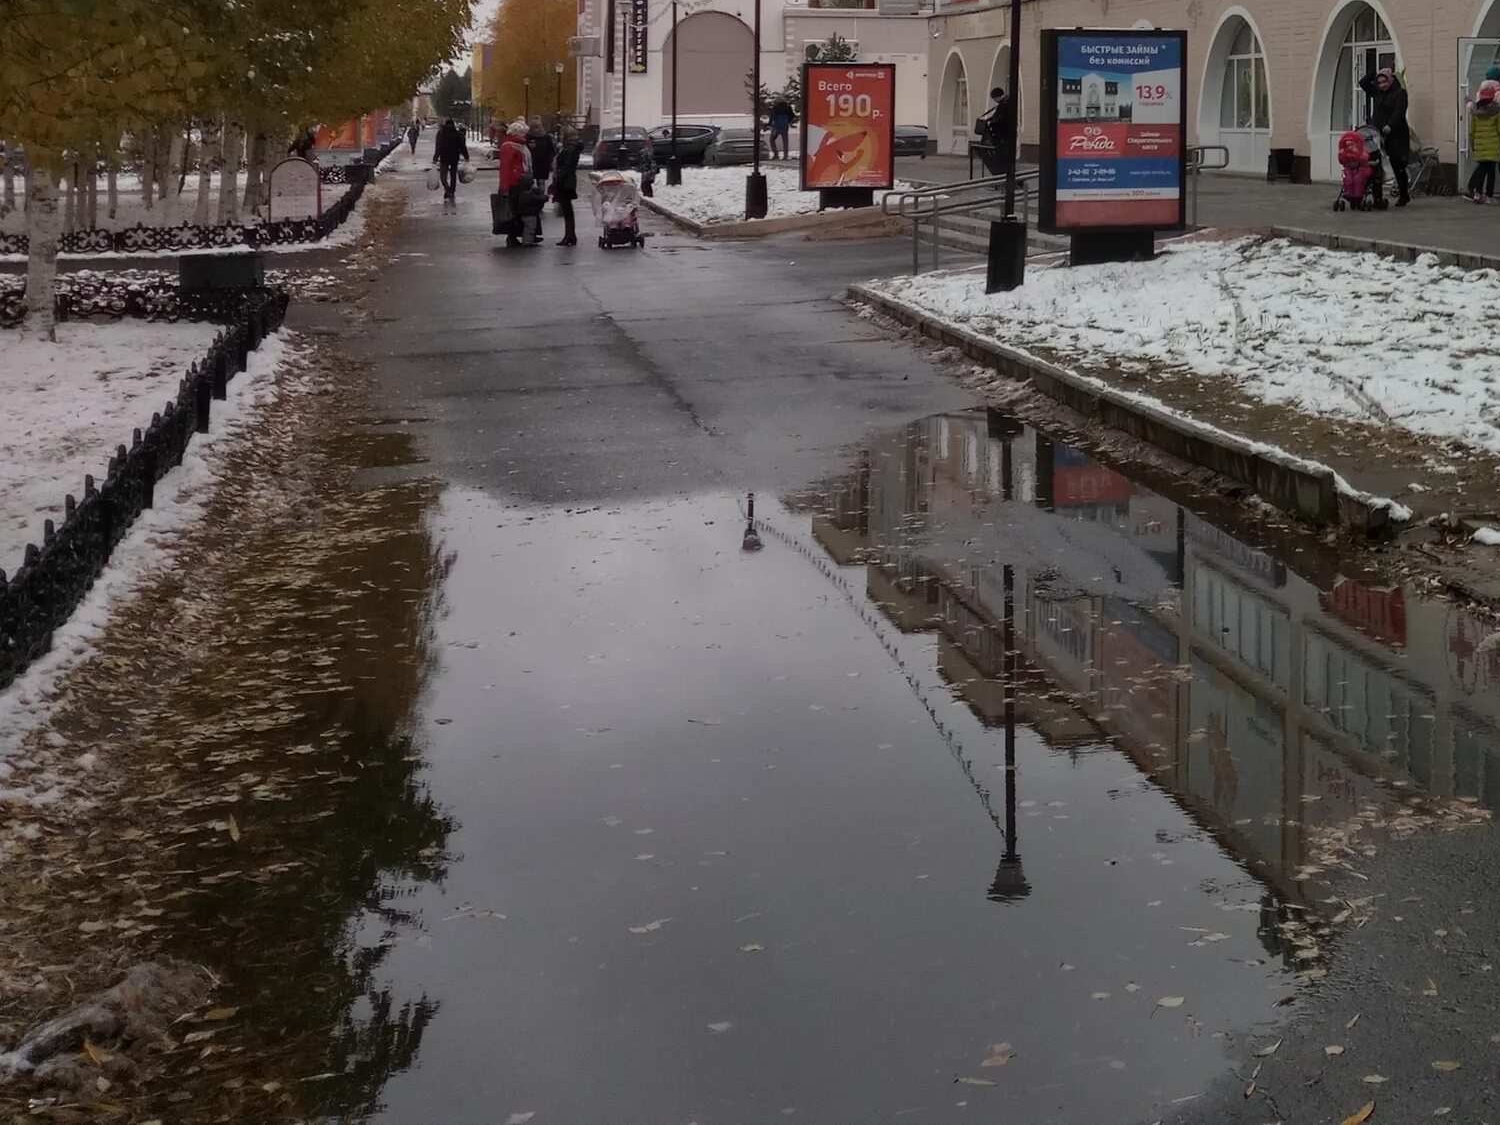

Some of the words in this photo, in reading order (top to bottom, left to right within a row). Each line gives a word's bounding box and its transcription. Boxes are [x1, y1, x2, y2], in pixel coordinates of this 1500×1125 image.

[1081, 45, 1124, 54] БЫСТРЫЕ
[1125, 44, 1159, 55] ЗАЙМЫ
[1089, 56, 1105, 65] без
[1107, 56, 1150, 65] комиссий
[818, 81, 852, 91] Всего
[1070, 136, 1115, 150] Ренда
